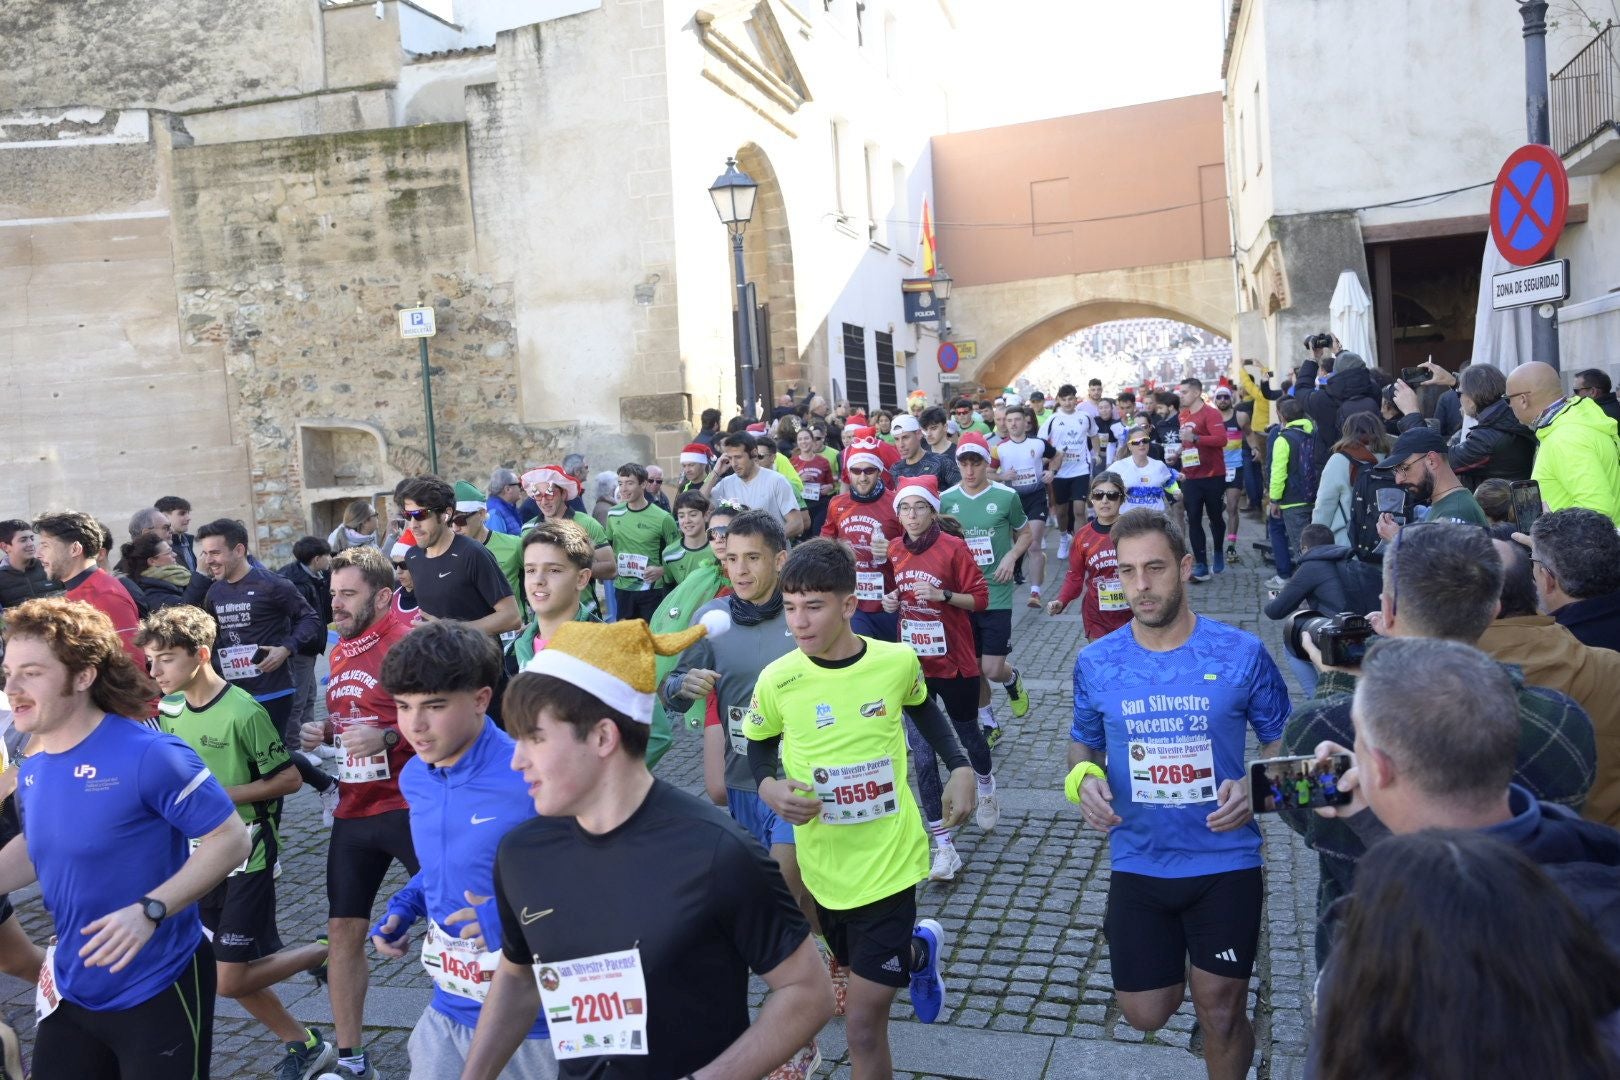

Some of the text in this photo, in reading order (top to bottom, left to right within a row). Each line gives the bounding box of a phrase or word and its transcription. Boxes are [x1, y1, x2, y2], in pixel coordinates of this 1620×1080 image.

[1497, 274, 1559, 297] ZONA DE SEGURIDAD
[845, 525, 873, 534] PACENSE
[1088, 553, 1099, 566] SAN
[1095, 559, 1118, 570] PACEN
[905, 569, 942, 588] SILVESTRE
[225, 602, 251, 613] Silvestre
[911, 632, 932, 645] 905
[340, 669, 378, 690] SILVESTRE
[331, 685, 363, 701] PACENSE
[1121, 694, 1210, 716] San Silvestre
[1125, 717, 1184, 735] Pacense
[1145, 743, 1210, 755] San Silvestre Pacense
[828, 768, 840, 777] San
[841, 764, 866, 776] Silvestre
[866, 758, 890, 770] Pacense
[1148, 763, 1195, 785] 1269
[832, 780, 878, 805] 1559
[556, 961, 573, 977] San
[572, 960, 606, 976] Silvestre
[604, 955, 637, 971] Pacense
[571, 991, 623, 1024] 2201
